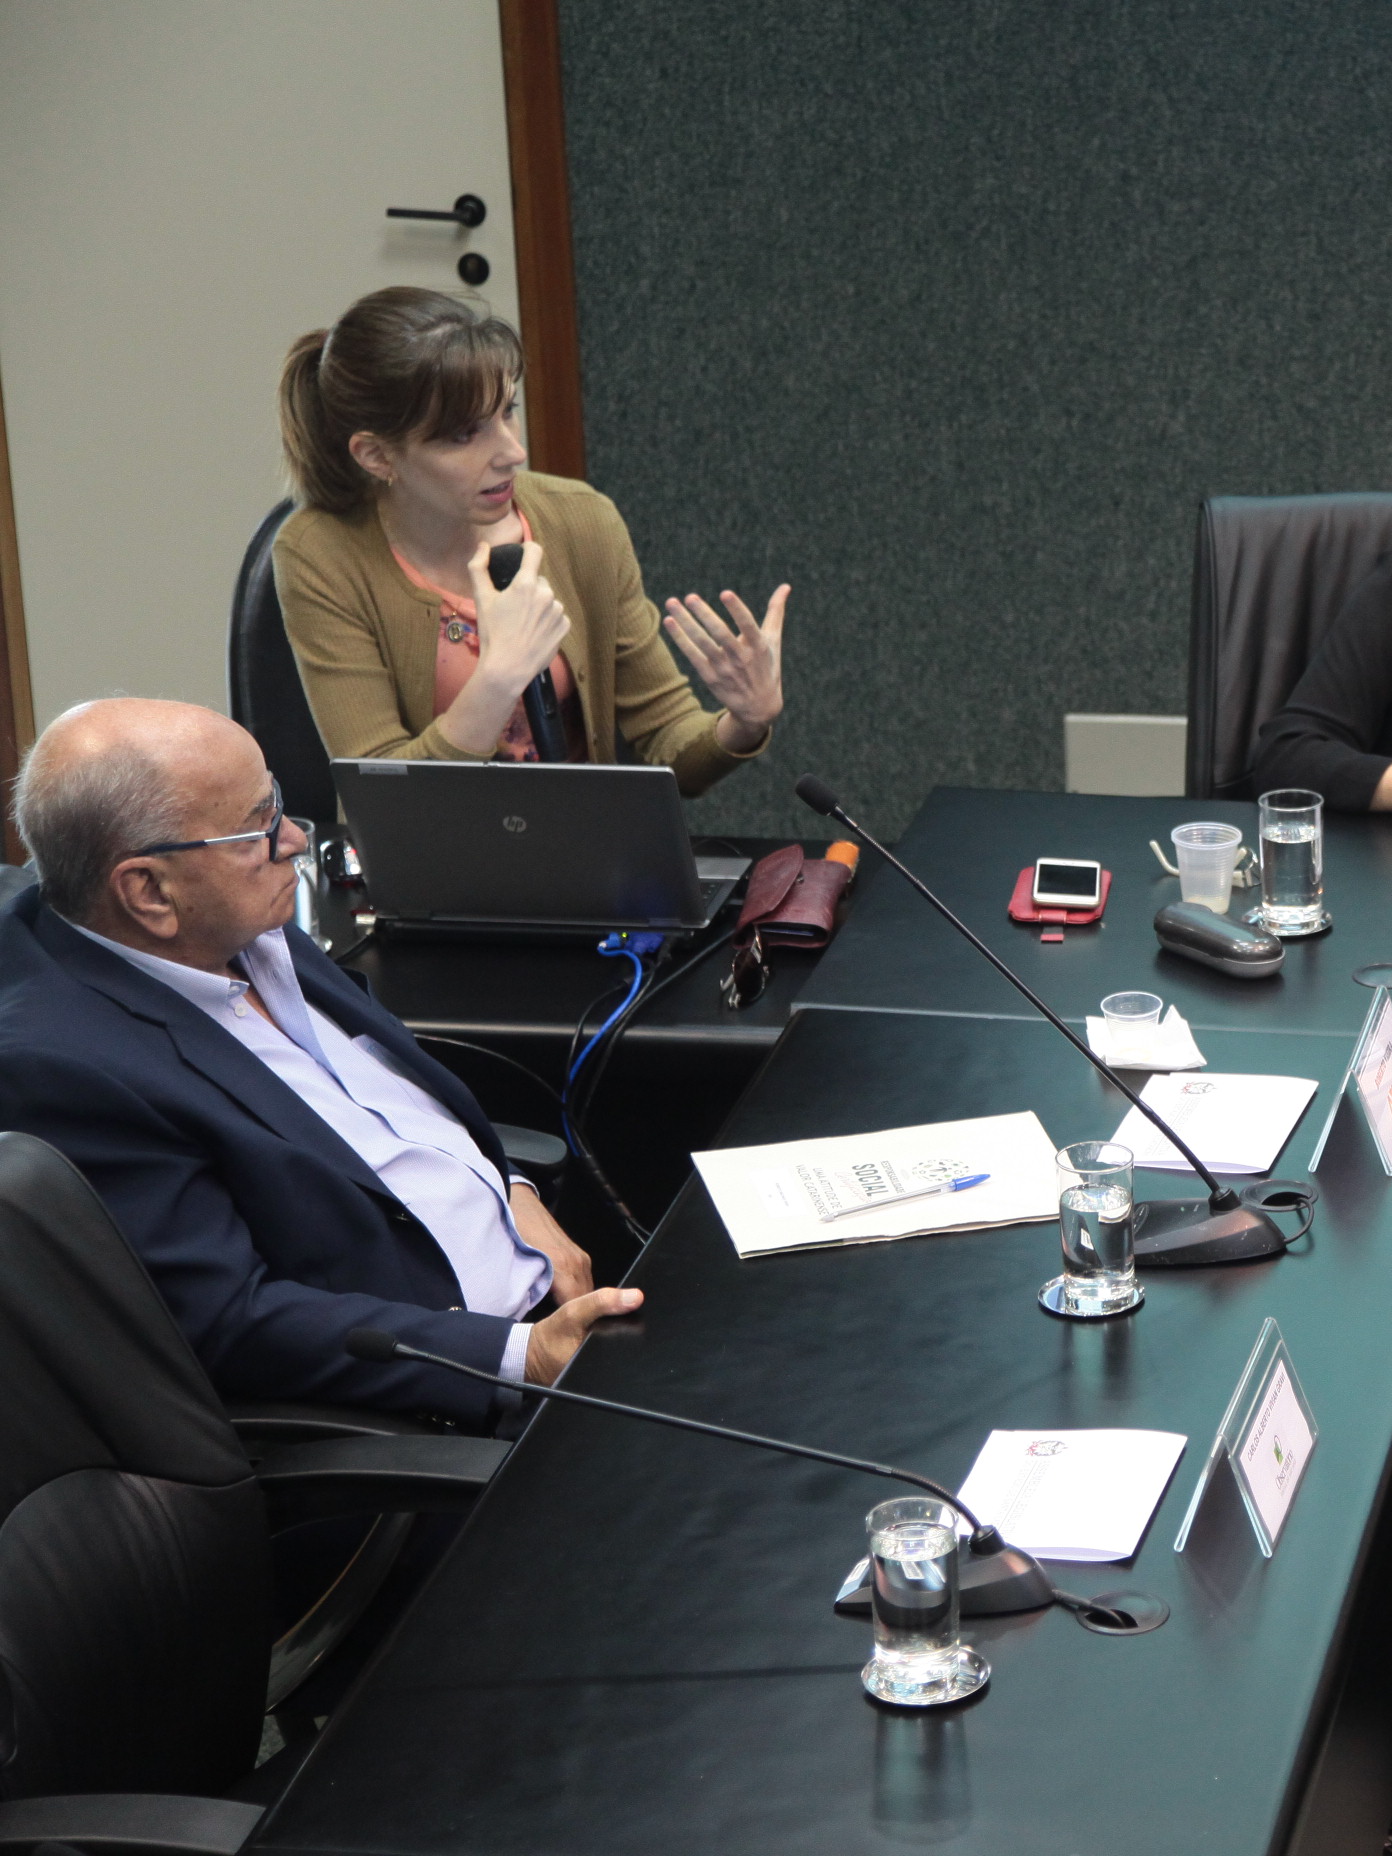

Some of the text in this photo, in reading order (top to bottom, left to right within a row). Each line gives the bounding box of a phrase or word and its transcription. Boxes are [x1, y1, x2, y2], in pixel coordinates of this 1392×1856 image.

[503, 815, 527, 832] hp
[795, 1164, 812, 1182] VALOR
[812, 1167, 828, 1180] UMA
[851, 1163, 889, 1197] SOCIAL
[818, 1178, 839, 1201] ATITUDE
[1247, 1433, 1260, 1462] CARLOS
